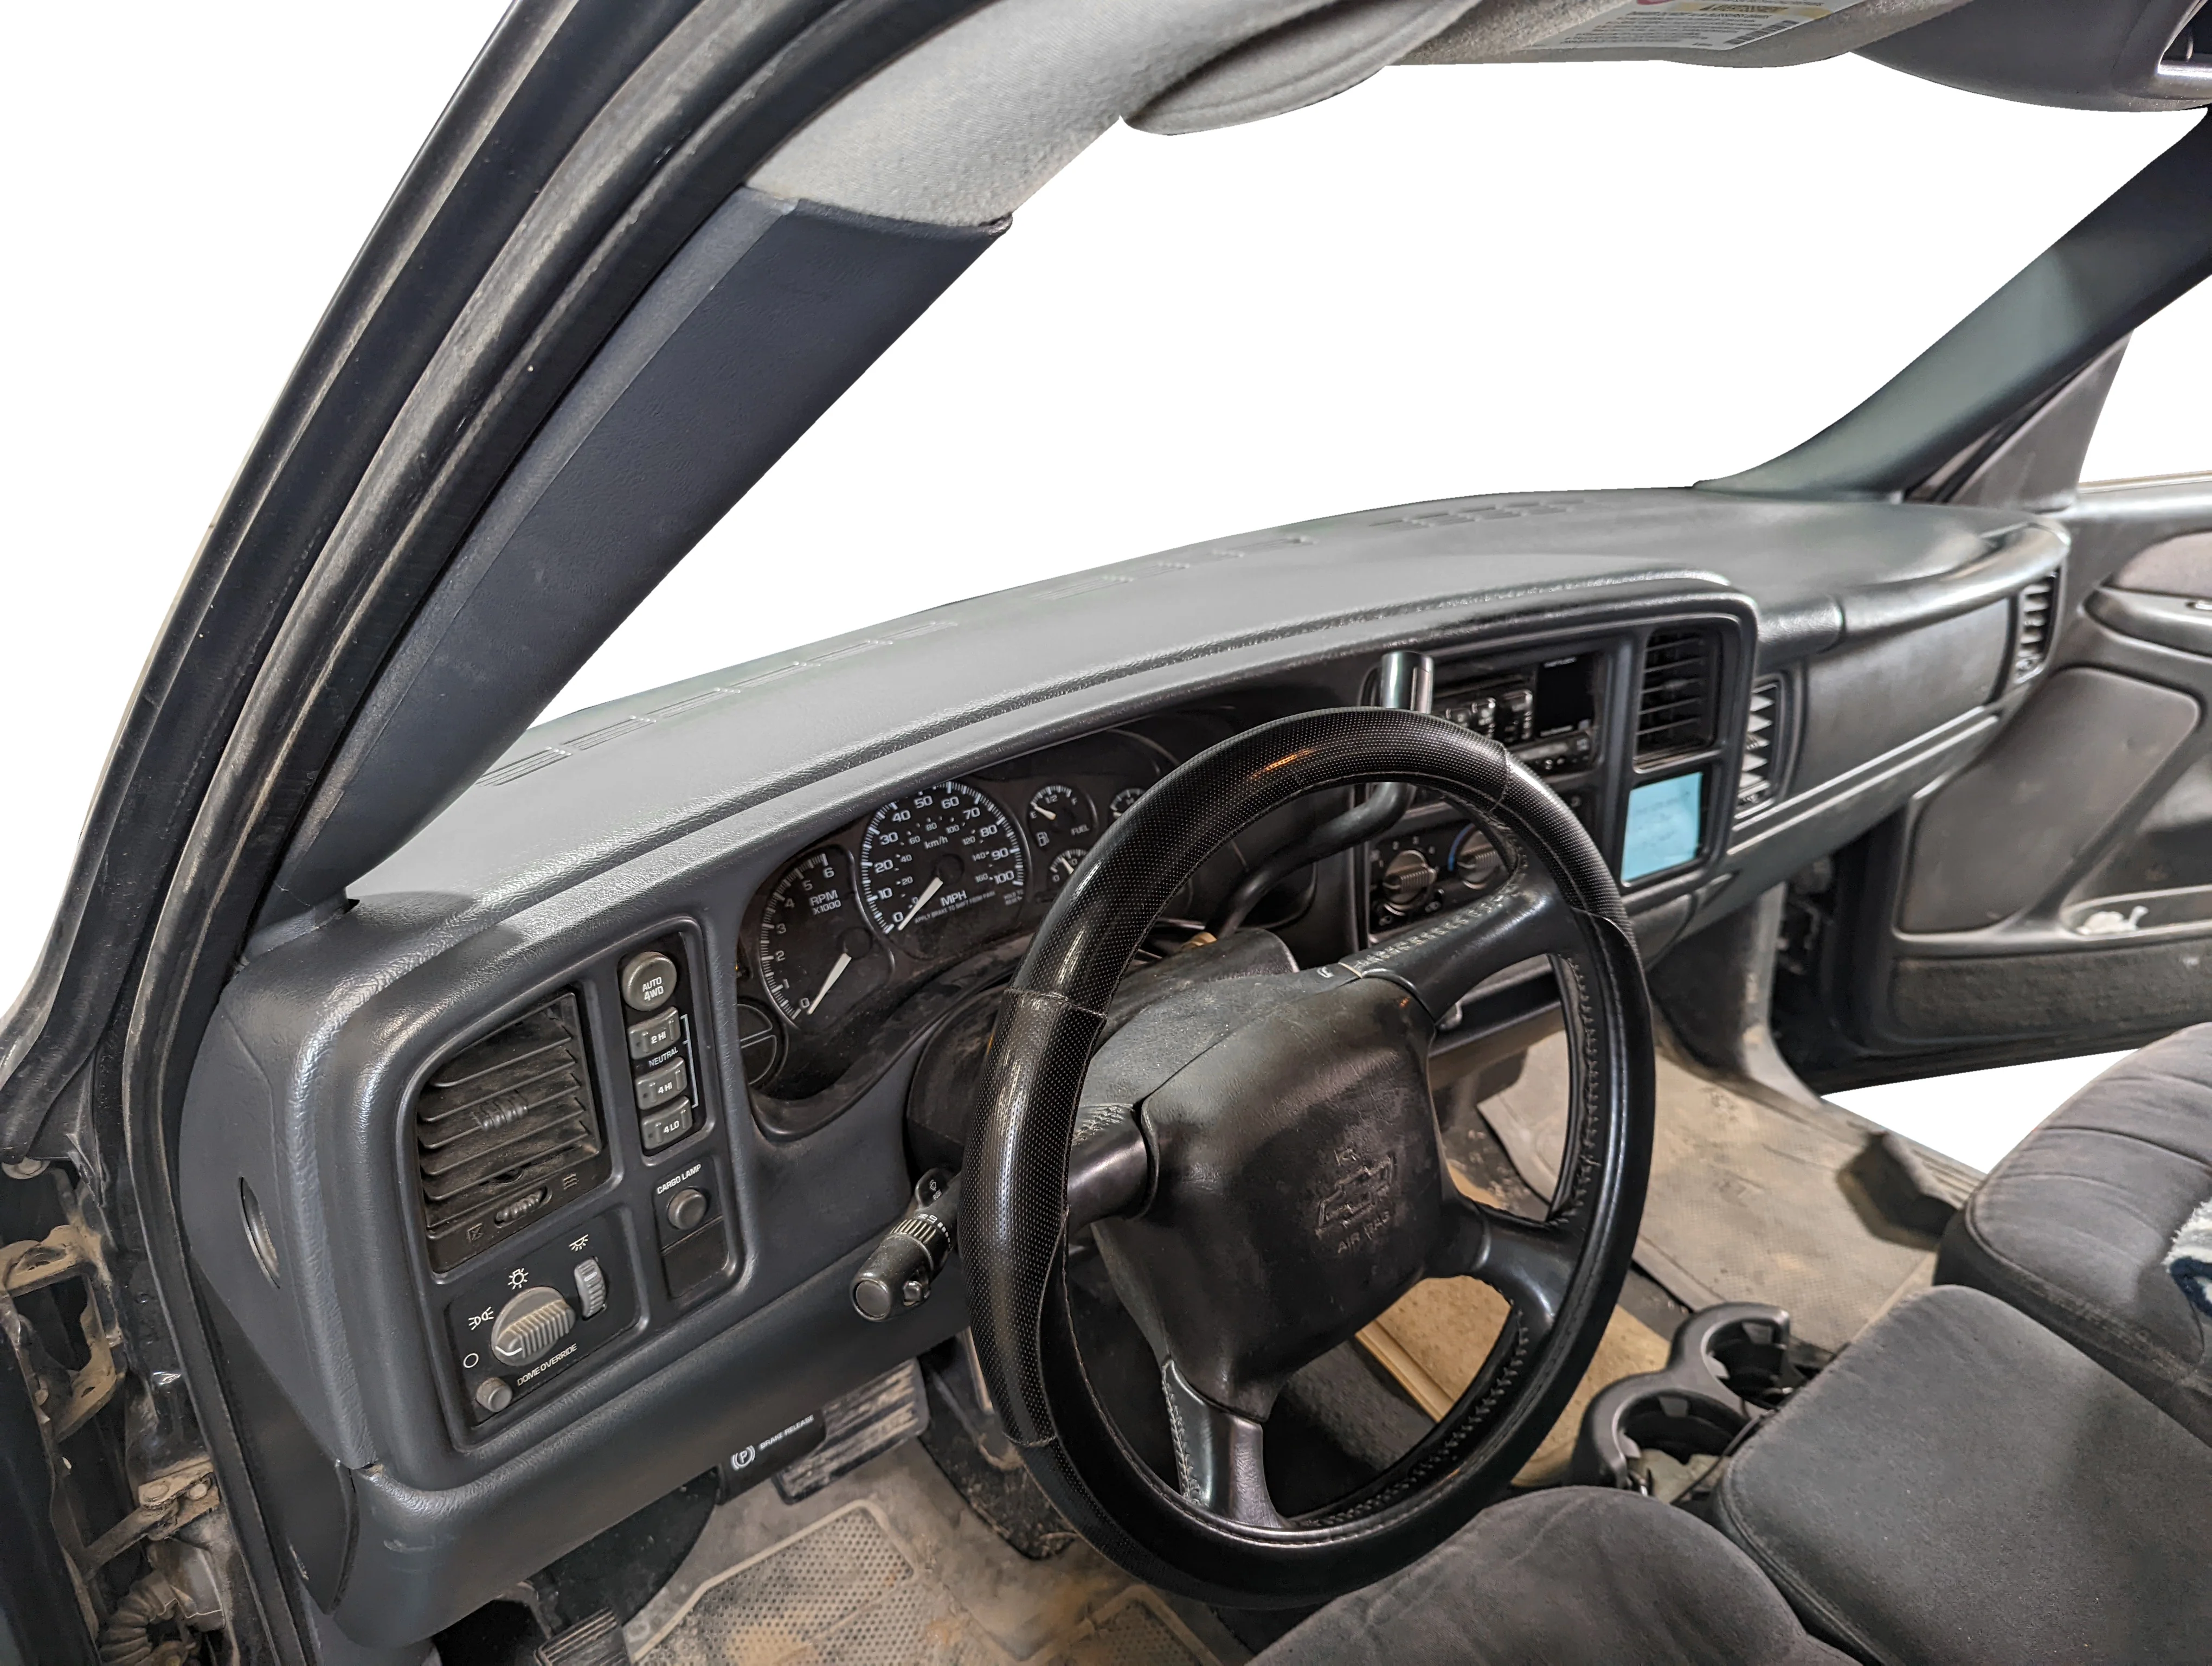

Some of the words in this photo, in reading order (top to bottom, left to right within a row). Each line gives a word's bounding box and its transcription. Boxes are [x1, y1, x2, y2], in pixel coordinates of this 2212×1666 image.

[914, 796, 933, 809] 50
[941, 796, 959, 809] 60
[892, 810, 911, 822] 40
[962, 807, 980, 819] 70
[925, 822, 937, 831] 80
[946, 824, 960, 834] 100
[980, 824, 998, 837] 80
[1071, 824, 1089, 835] FUEL
[879, 832, 899, 845] 30
[909, 836, 921, 844] 60
[924, 836, 948, 849] km/h
[962, 836, 975, 845] 120
[901, 854, 912, 862] 40
[972, 853, 986, 861] 140
[991, 847, 1009, 860] 90
[824, 868, 834, 877] 6
[874, 860, 893, 874] 20
[902, 876, 913, 886] 20
[975, 873, 988, 883] 160
[994, 870, 1014, 884] 100
[803, 880, 813, 890] 5
[810, 890, 838, 906] RPM
[878, 888, 892, 899] 10
[940, 890, 967, 907] MPH
[785, 898, 795, 909] 4
[813, 900, 841, 915] X1000
[893, 912, 903, 922] 0
[915, 913, 930, 924] APPLY
[775, 923, 786, 934] 3
[776, 950, 785, 961] 2
[642, 977, 662, 992] AUTO
[783, 979, 790, 989] 1
[644, 986, 664, 1001] 4WD
[800, 998, 810, 1009] 0
[651, 1036, 657, 1045] 2
[658, 1031, 666, 1041] HI
[648, 1047, 678, 1067] NEUTRAL
[665, 1082, 672, 1092] HI
[670, 1120, 680, 1131] LO
[657, 1176, 681, 1194] CARGO
[681, 1164, 701, 1180] LAMP
[1338, 1231, 1360, 1253] AIR
[517, 1367, 541, 1386] DOME
[540, 1343, 577, 1371] OVERRIDE
[760, 1432, 783, 1451] BRAKE
[784, 1414, 814, 1436] RELEASE
